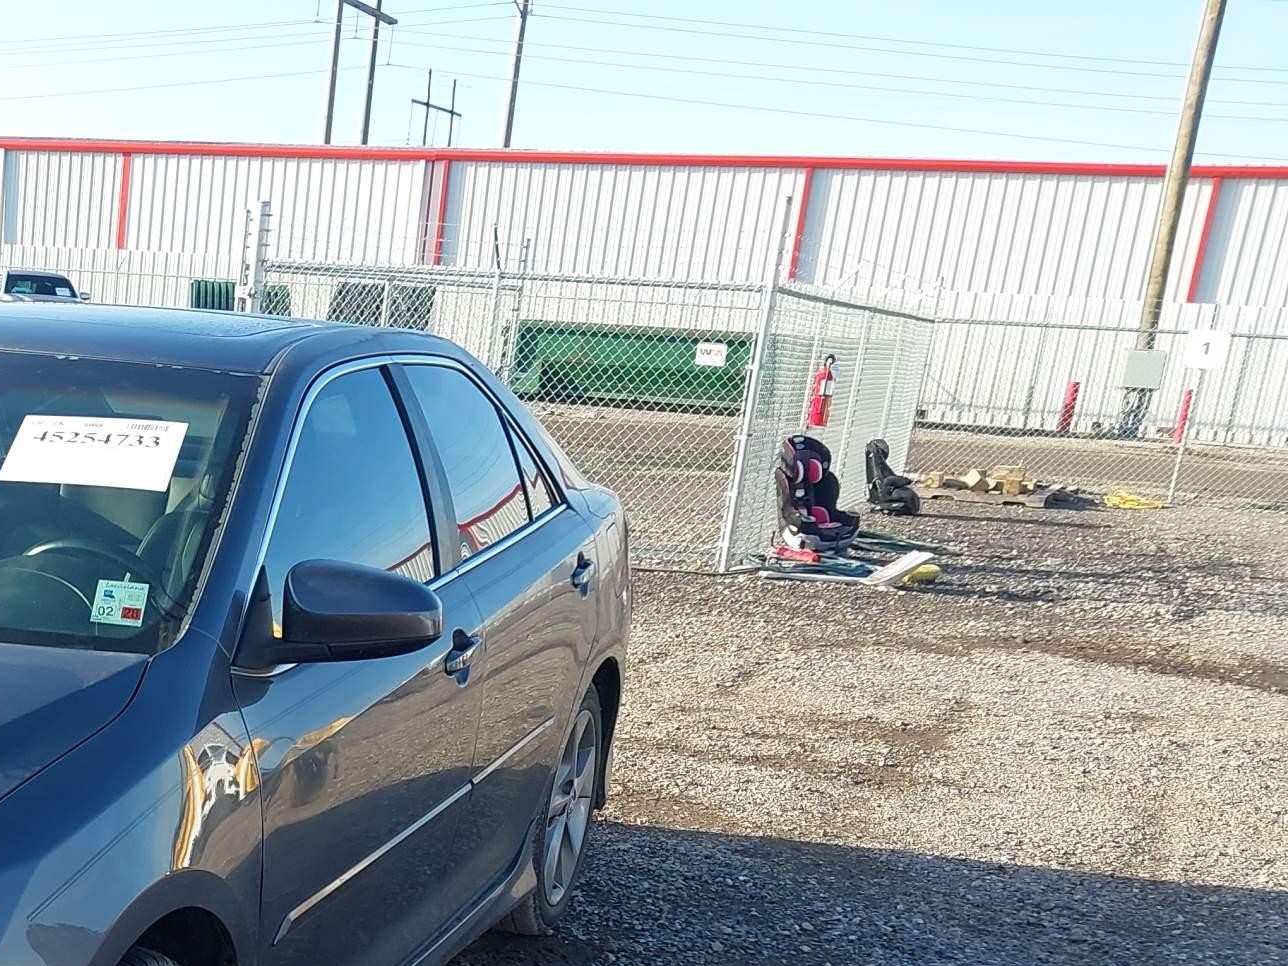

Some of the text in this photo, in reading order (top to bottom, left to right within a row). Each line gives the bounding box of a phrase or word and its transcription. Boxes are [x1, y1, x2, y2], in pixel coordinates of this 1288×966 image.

[1202, 342, 1211, 355] 1
[33, 430, 160, 449] 45254733
[98, 606, 114, 617] 02
